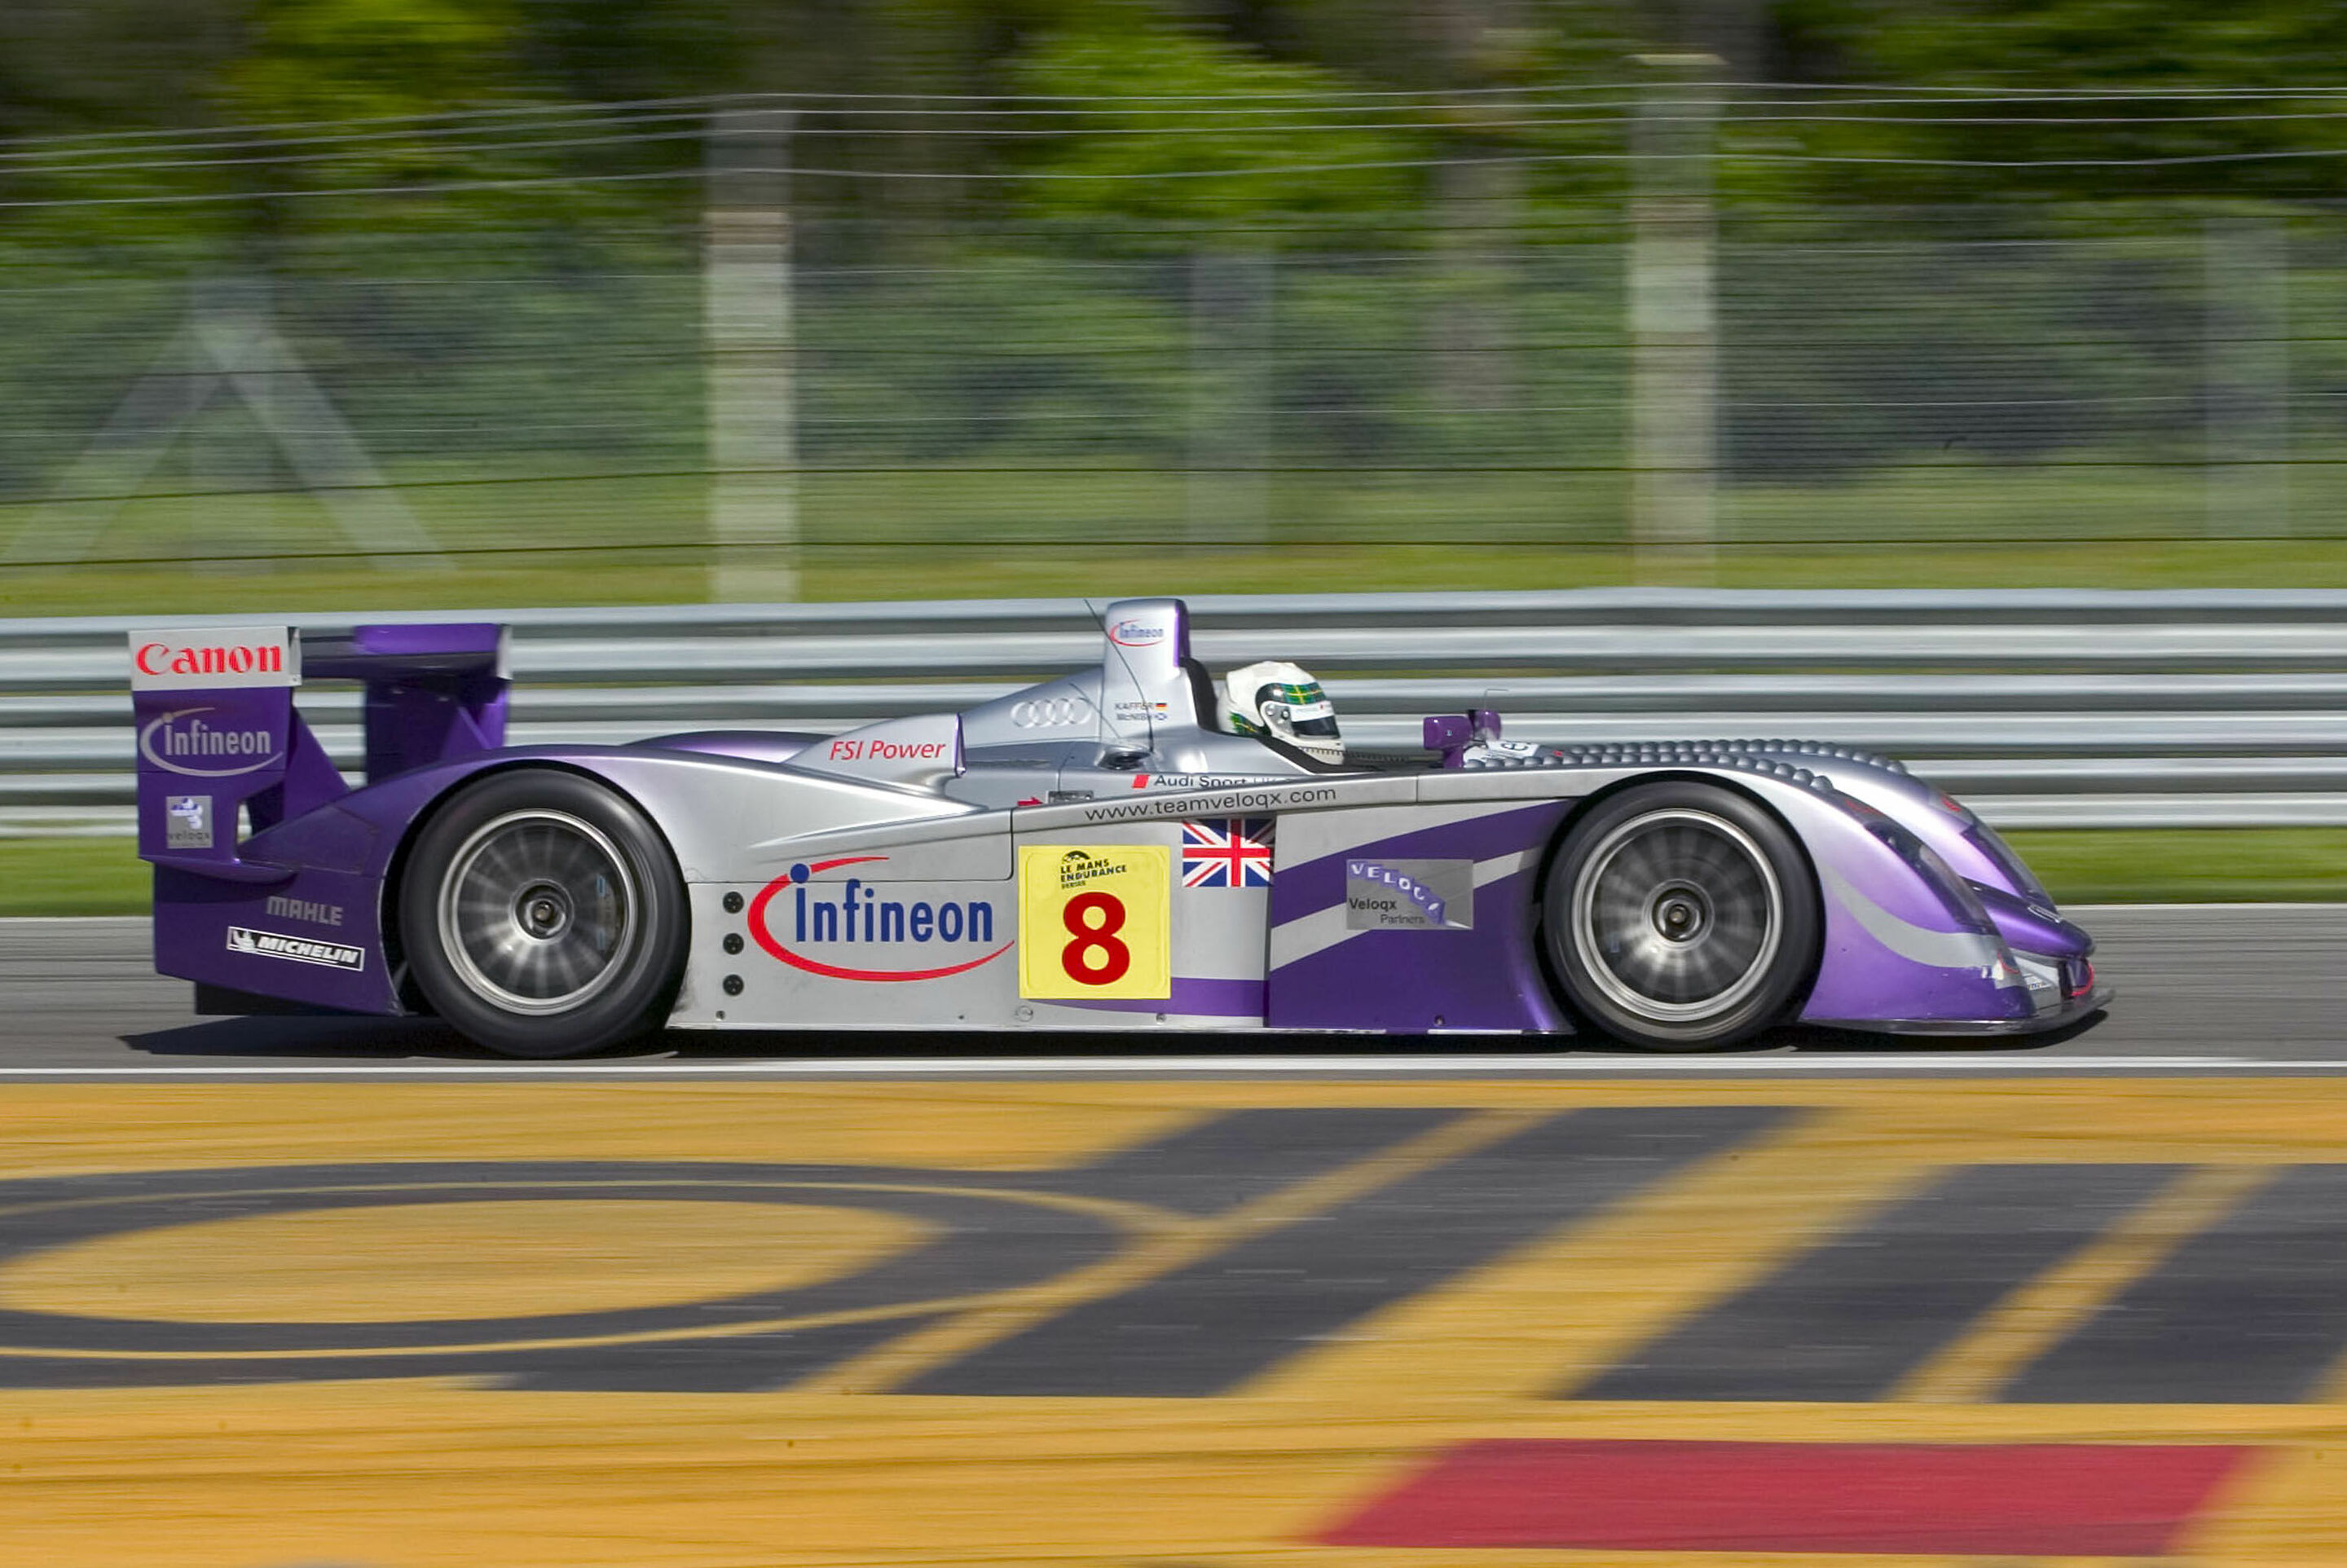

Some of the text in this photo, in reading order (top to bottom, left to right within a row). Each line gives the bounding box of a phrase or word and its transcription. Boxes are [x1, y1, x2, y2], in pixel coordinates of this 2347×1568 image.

[135, 643, 282, 675] Canon
[830, 740, 945, 760] FSI Power
[1154, 774, 1194, 787] Audi
[1085, 787, 1336, 821] www.teamveloqx.com
[1061, 859, 1109, 874] LE MANS
[1061, 865, 1127, 883] ENDURANCE
[266, 896, 343, 927] MAHLE
[1349, 896, 1398, 912] Veloqx
[257, 936, 359, 963] MICHELIN
[1061, 892, 1130, 985] 8
